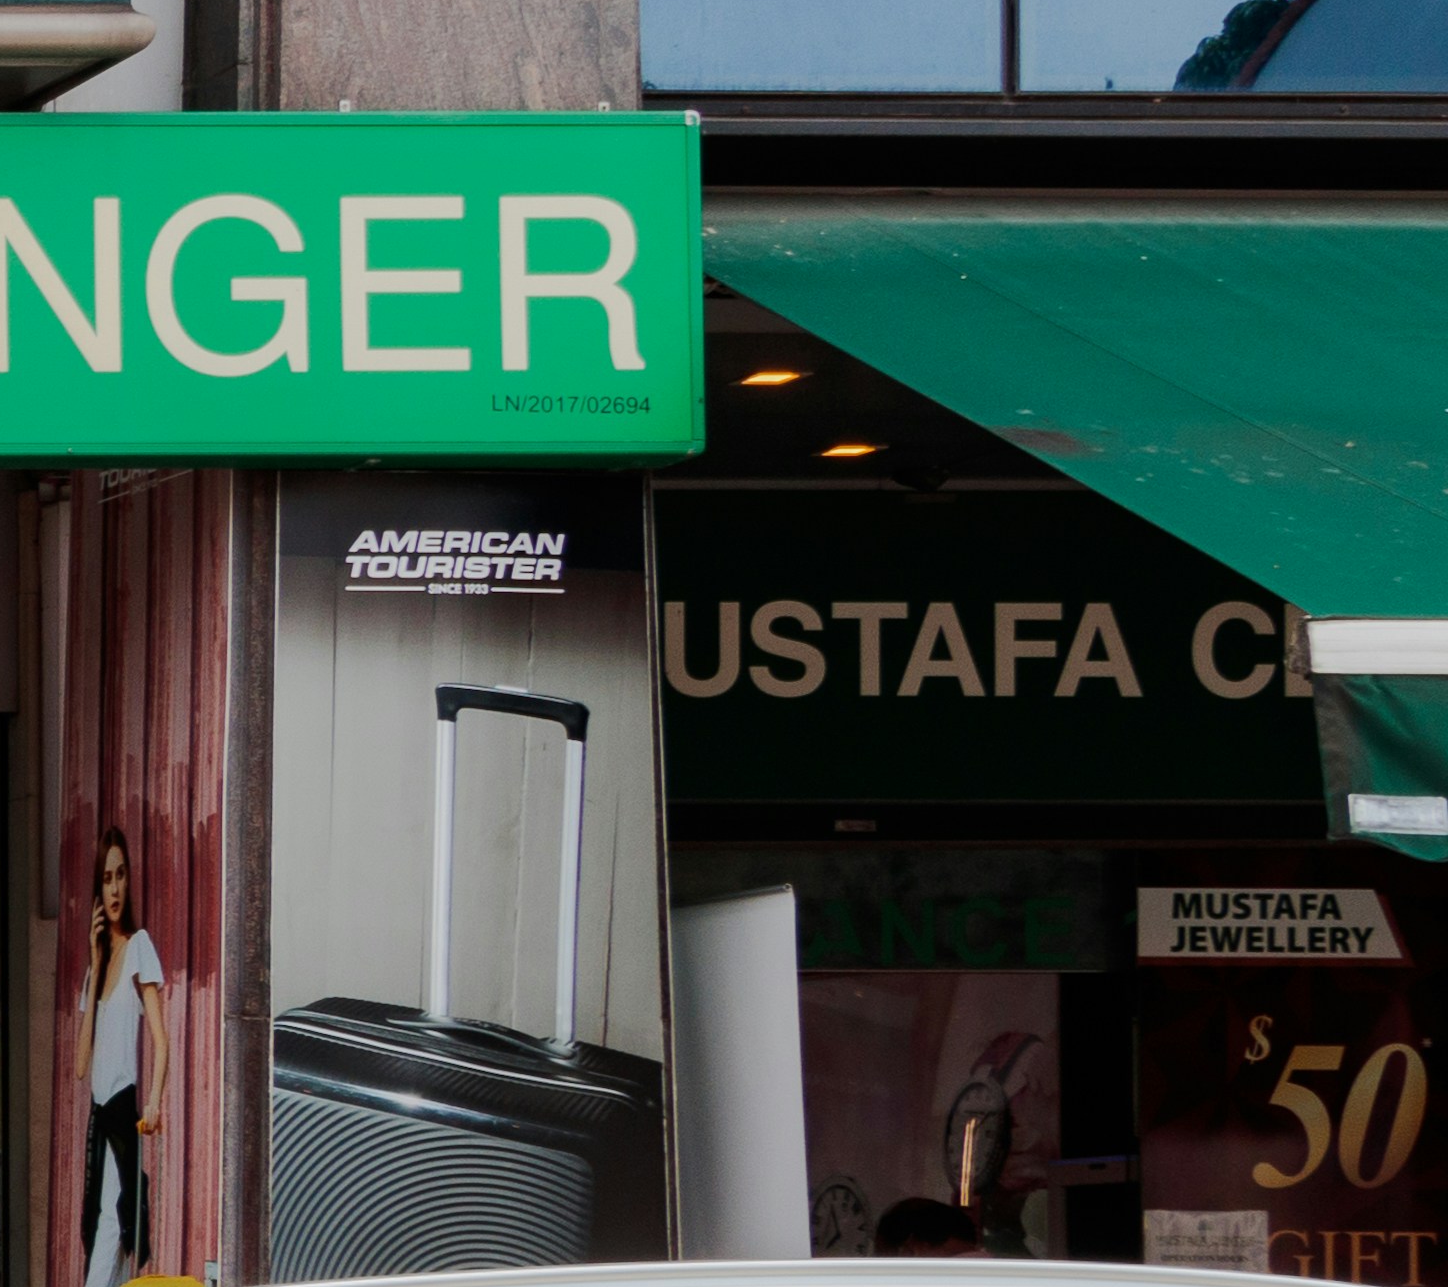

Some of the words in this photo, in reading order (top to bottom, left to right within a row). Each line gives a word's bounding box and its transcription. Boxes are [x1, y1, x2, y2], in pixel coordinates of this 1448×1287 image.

[490, 393, 652, 416] LN/2017/02694
[348, 529, 566, 557] AMERICAN
[345, 556, 563, 582] TOURISTER
[428, 583, 463, 594] SINCE
[465, 584, 489, 595] 1933
[664, 600, 1143, 699] USTAFA
[1171, 893, 1342, 921] MUSTAFA
[1170, 926, 1373, 954] JEWELLERY
[1267, 1229, 1438, 1287] GIFT
